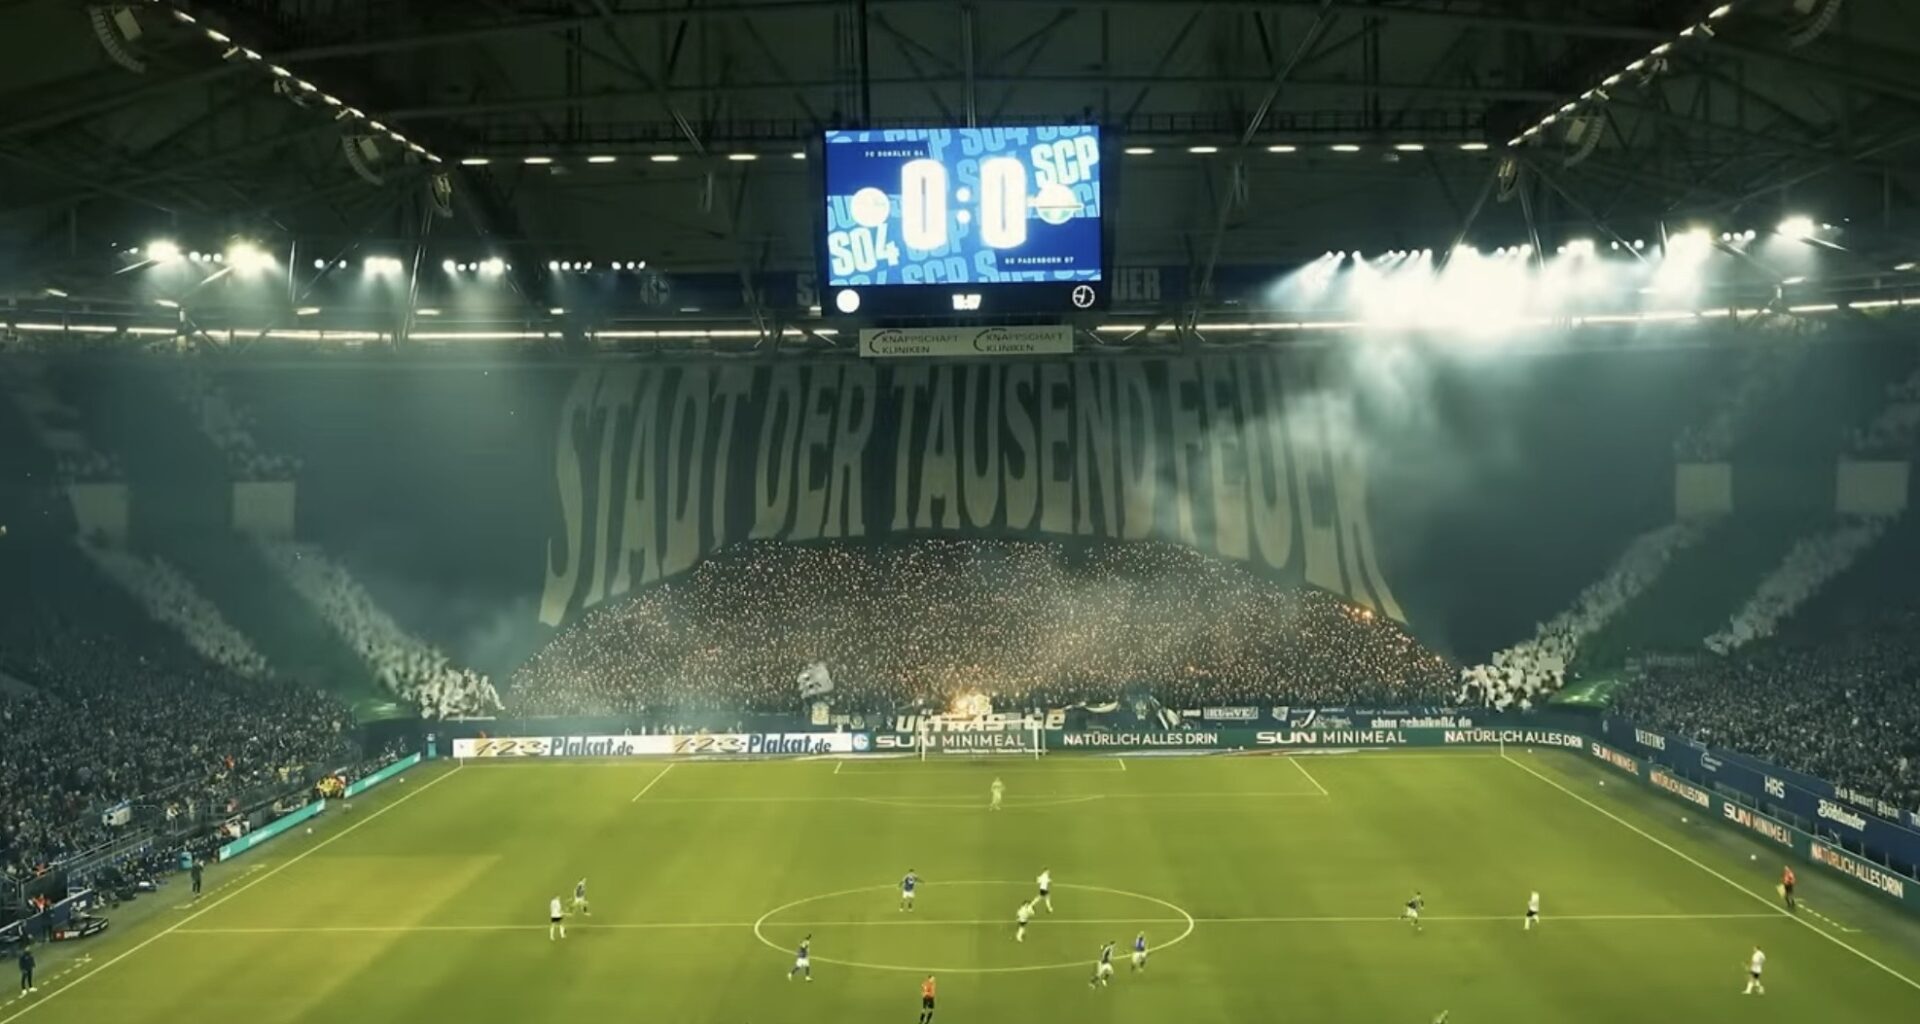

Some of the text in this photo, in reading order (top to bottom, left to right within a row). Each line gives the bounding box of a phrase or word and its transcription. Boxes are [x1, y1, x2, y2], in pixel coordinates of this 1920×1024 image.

[1031, 135, 1099, 188] SCP
[881, 334, 959, 344] KNAPPSCHAFT
[986, 332, 1065, 342] KNAPPSCHAFT
[881, 345, 930, 355] KLINIKEN
[986, 343, 1034, 353] KLINIKEN
[538, 360, 1409, 628] STADT DER TAUSEND FEUER
[875, 734, 1026, 748] SUN MINIMEAL
[1063, 731, 1218, 746] NATÜRLICH ALLES DRIN
[1256, 730, 1407, 744] SUN MINIMEAL
[1444, 727, 1522, 743] NATÜRLICH
[1525, 730, 1562, 744] ALLES
[1763, 775, 1785, 799] HRS
[1723, 801, 1751, 828] SUN
[1810, 841, 1904, 899] NATÜRLICH ALLES DRIN
